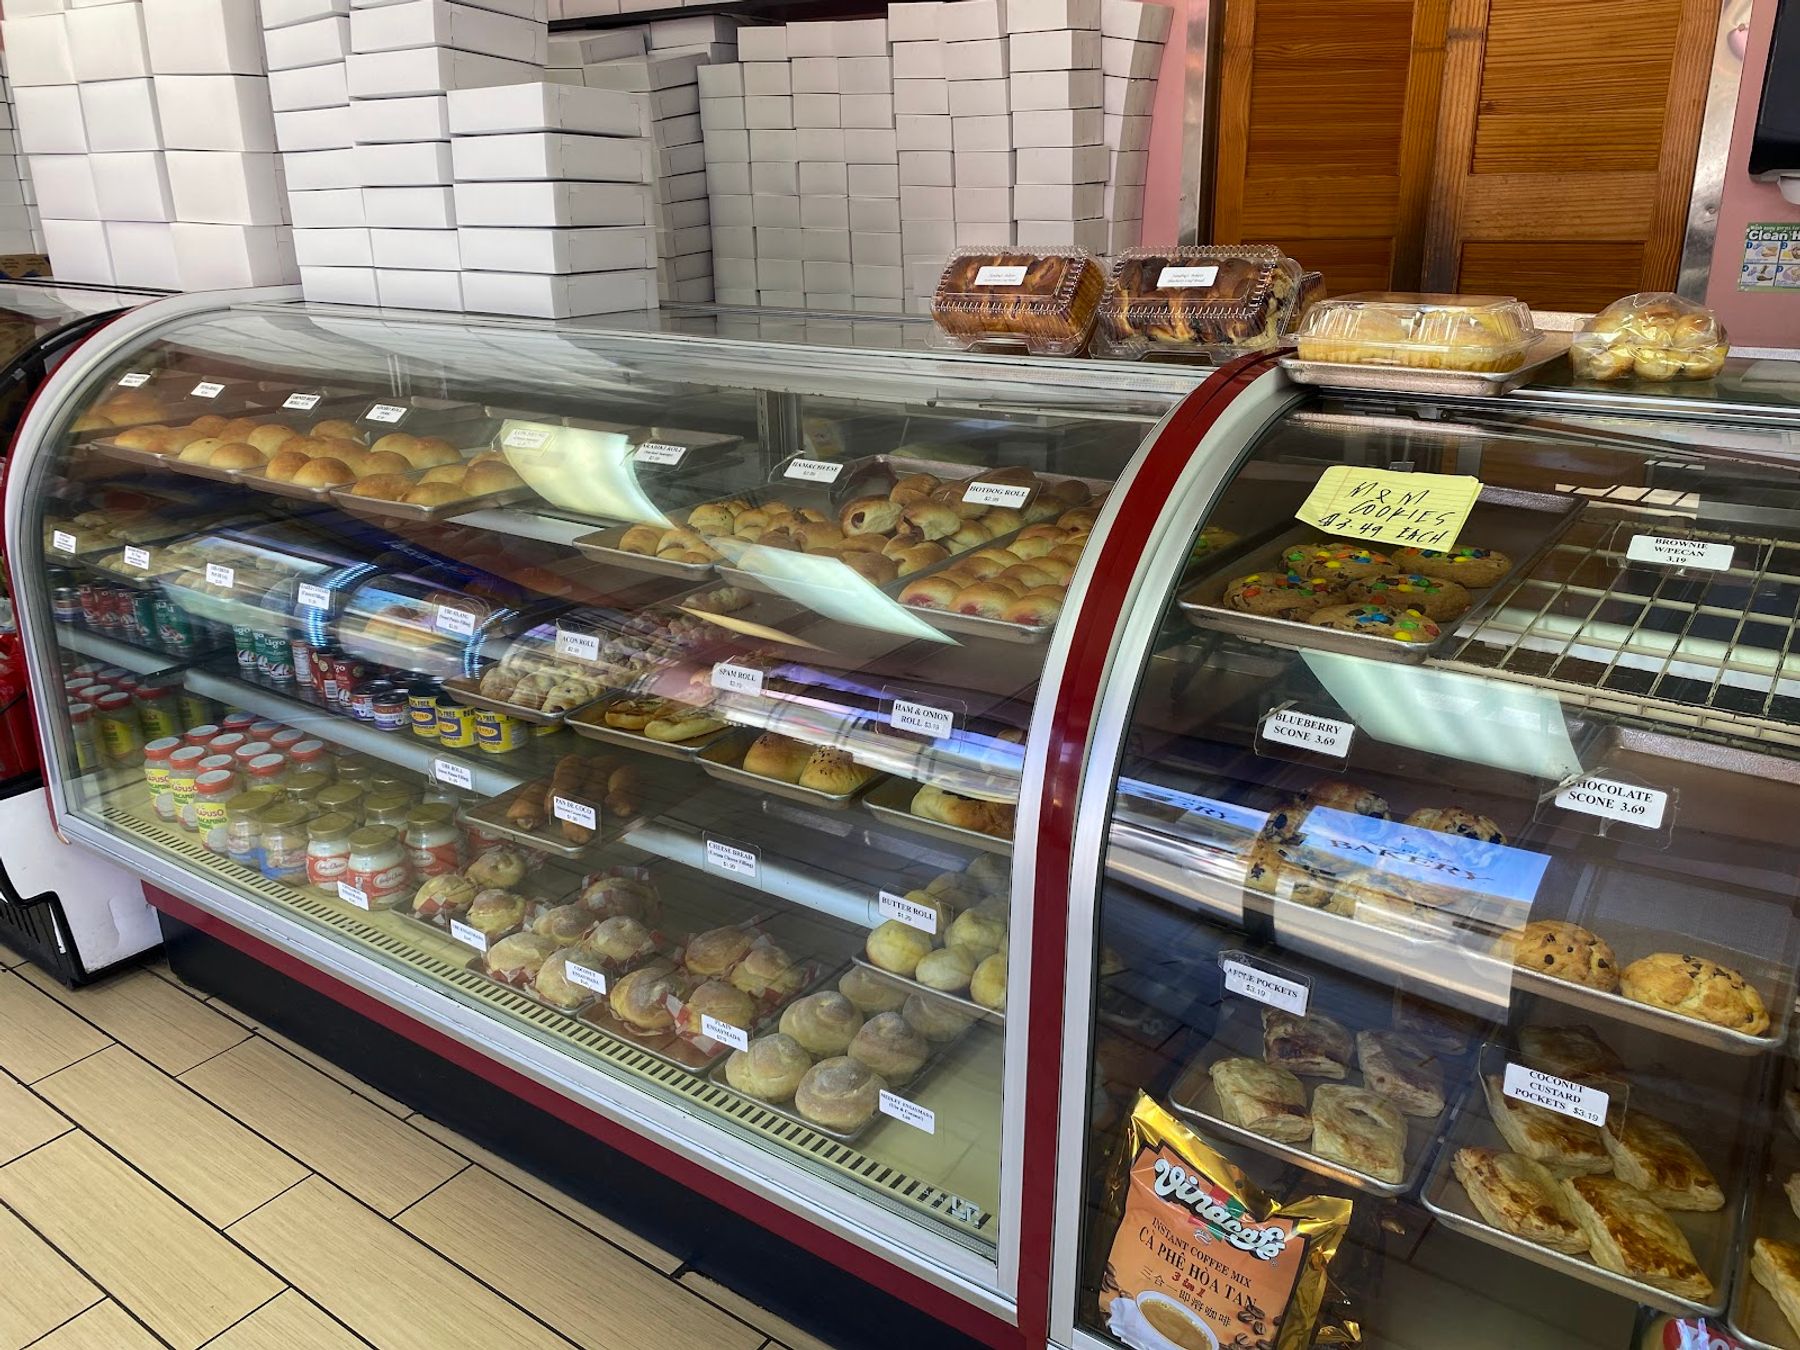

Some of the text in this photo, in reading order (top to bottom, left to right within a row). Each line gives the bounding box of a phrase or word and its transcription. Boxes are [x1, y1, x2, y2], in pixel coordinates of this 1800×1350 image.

[1748, 229, 1788, 241] Clean
[970, 485, 1026, 498] HOTDOG ROLL
[1348, 499, 1456, 527] COOKIES
[1396, 527, 1450, 546] EACH
[1655, 538, 1708, 550] BROWNIE
[1654, 546, 1706, 559] W/PECAN
[1666, 556, 1687, 566] 3.19
[579, 638, 595, 648] ROLL
[719, 668, 756, 682] SPAM ROLL
[895, 703, 914, 714] HAM
[922, 710, 949, 722] ONION
[901, 716, 922, 726] ROLL
[1275, 713, 1342, 736] BLUEBERRY
[1273, 726, 1336, 747] SCONE 3.69
[1575, 780, 1654, 803] HOCOLATE
[1568, 791, 1646, 815] SCONE 3.69
[708, 842, 753, 861] CHEESE BREAD
[1328, 839, 1494, 881] BAKERY
[881, 897, 935, 921] BUTTER ROLL
[1256, 978, 1298, 998] POCKETS
[1529, 1071, 1586, 1094] COCONUT
[1529, 1080, 1582, 1104] CUSTARD
[1515, 1088, 1599, 1122] POCKETS $3.19
[1151, 1217, 1253, 1289] INSTANT COFFEE MIX
[1139, 1226, 1258, 1308] CÀ PHÊ HÒA TAN
[1171, 1271, 1182, 1282] 3
[1182, 1280, 1195, 1292] in
